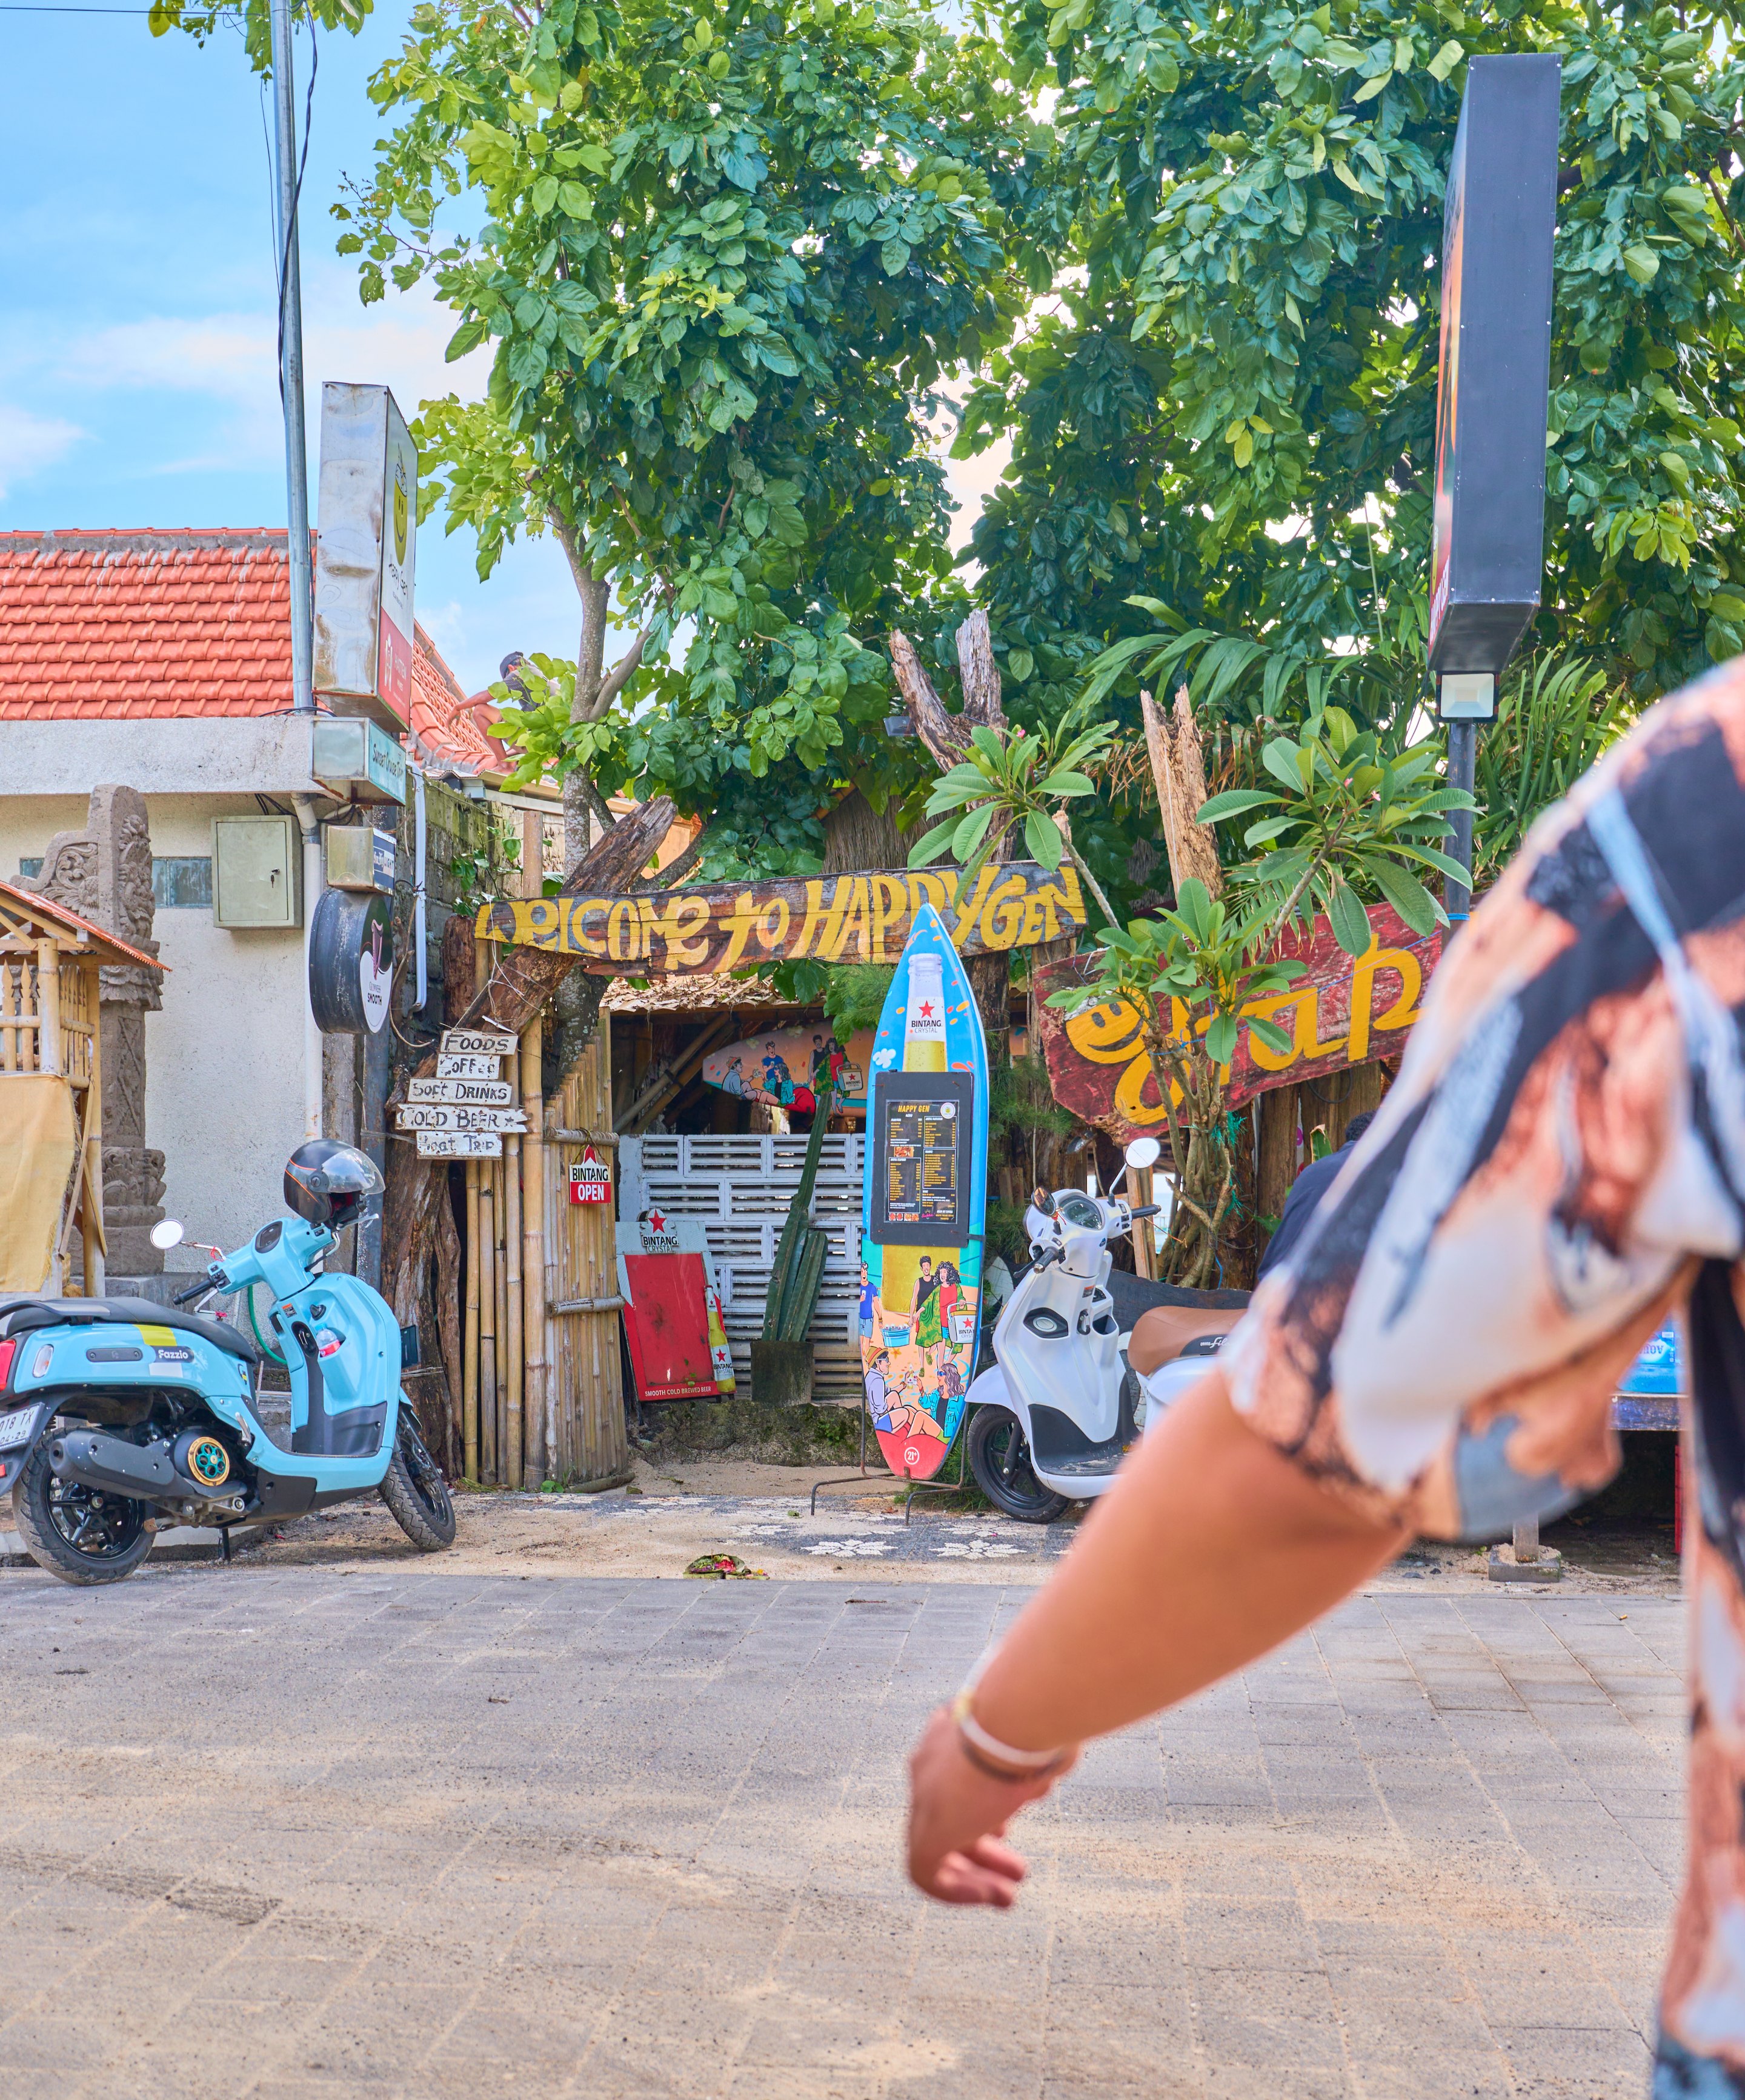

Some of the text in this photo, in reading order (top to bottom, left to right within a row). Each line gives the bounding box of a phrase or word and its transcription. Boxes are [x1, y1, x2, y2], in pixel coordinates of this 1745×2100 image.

[788, 865, 1000, 964] HAPPY
[980, 866, 1086, 950] GEN
[367, 992, 382, 1006] SMOOTH
[911, 1019, 942, 1028] BINTANG
[444, 1033, 509, 1053] FOODS
[456, 1083, 507, 1100] DRINKS
[457, 1108, 500, 1129] BEER
[572, 1167, 609, 1181] BINTANG
[577, 1184, 605, 1201] OPEN
[643, 1236, 678, 1245] BINTANG
[158, 1349, 188, 1359] Fazzio
[20, 1410, 35, 1425] TX
